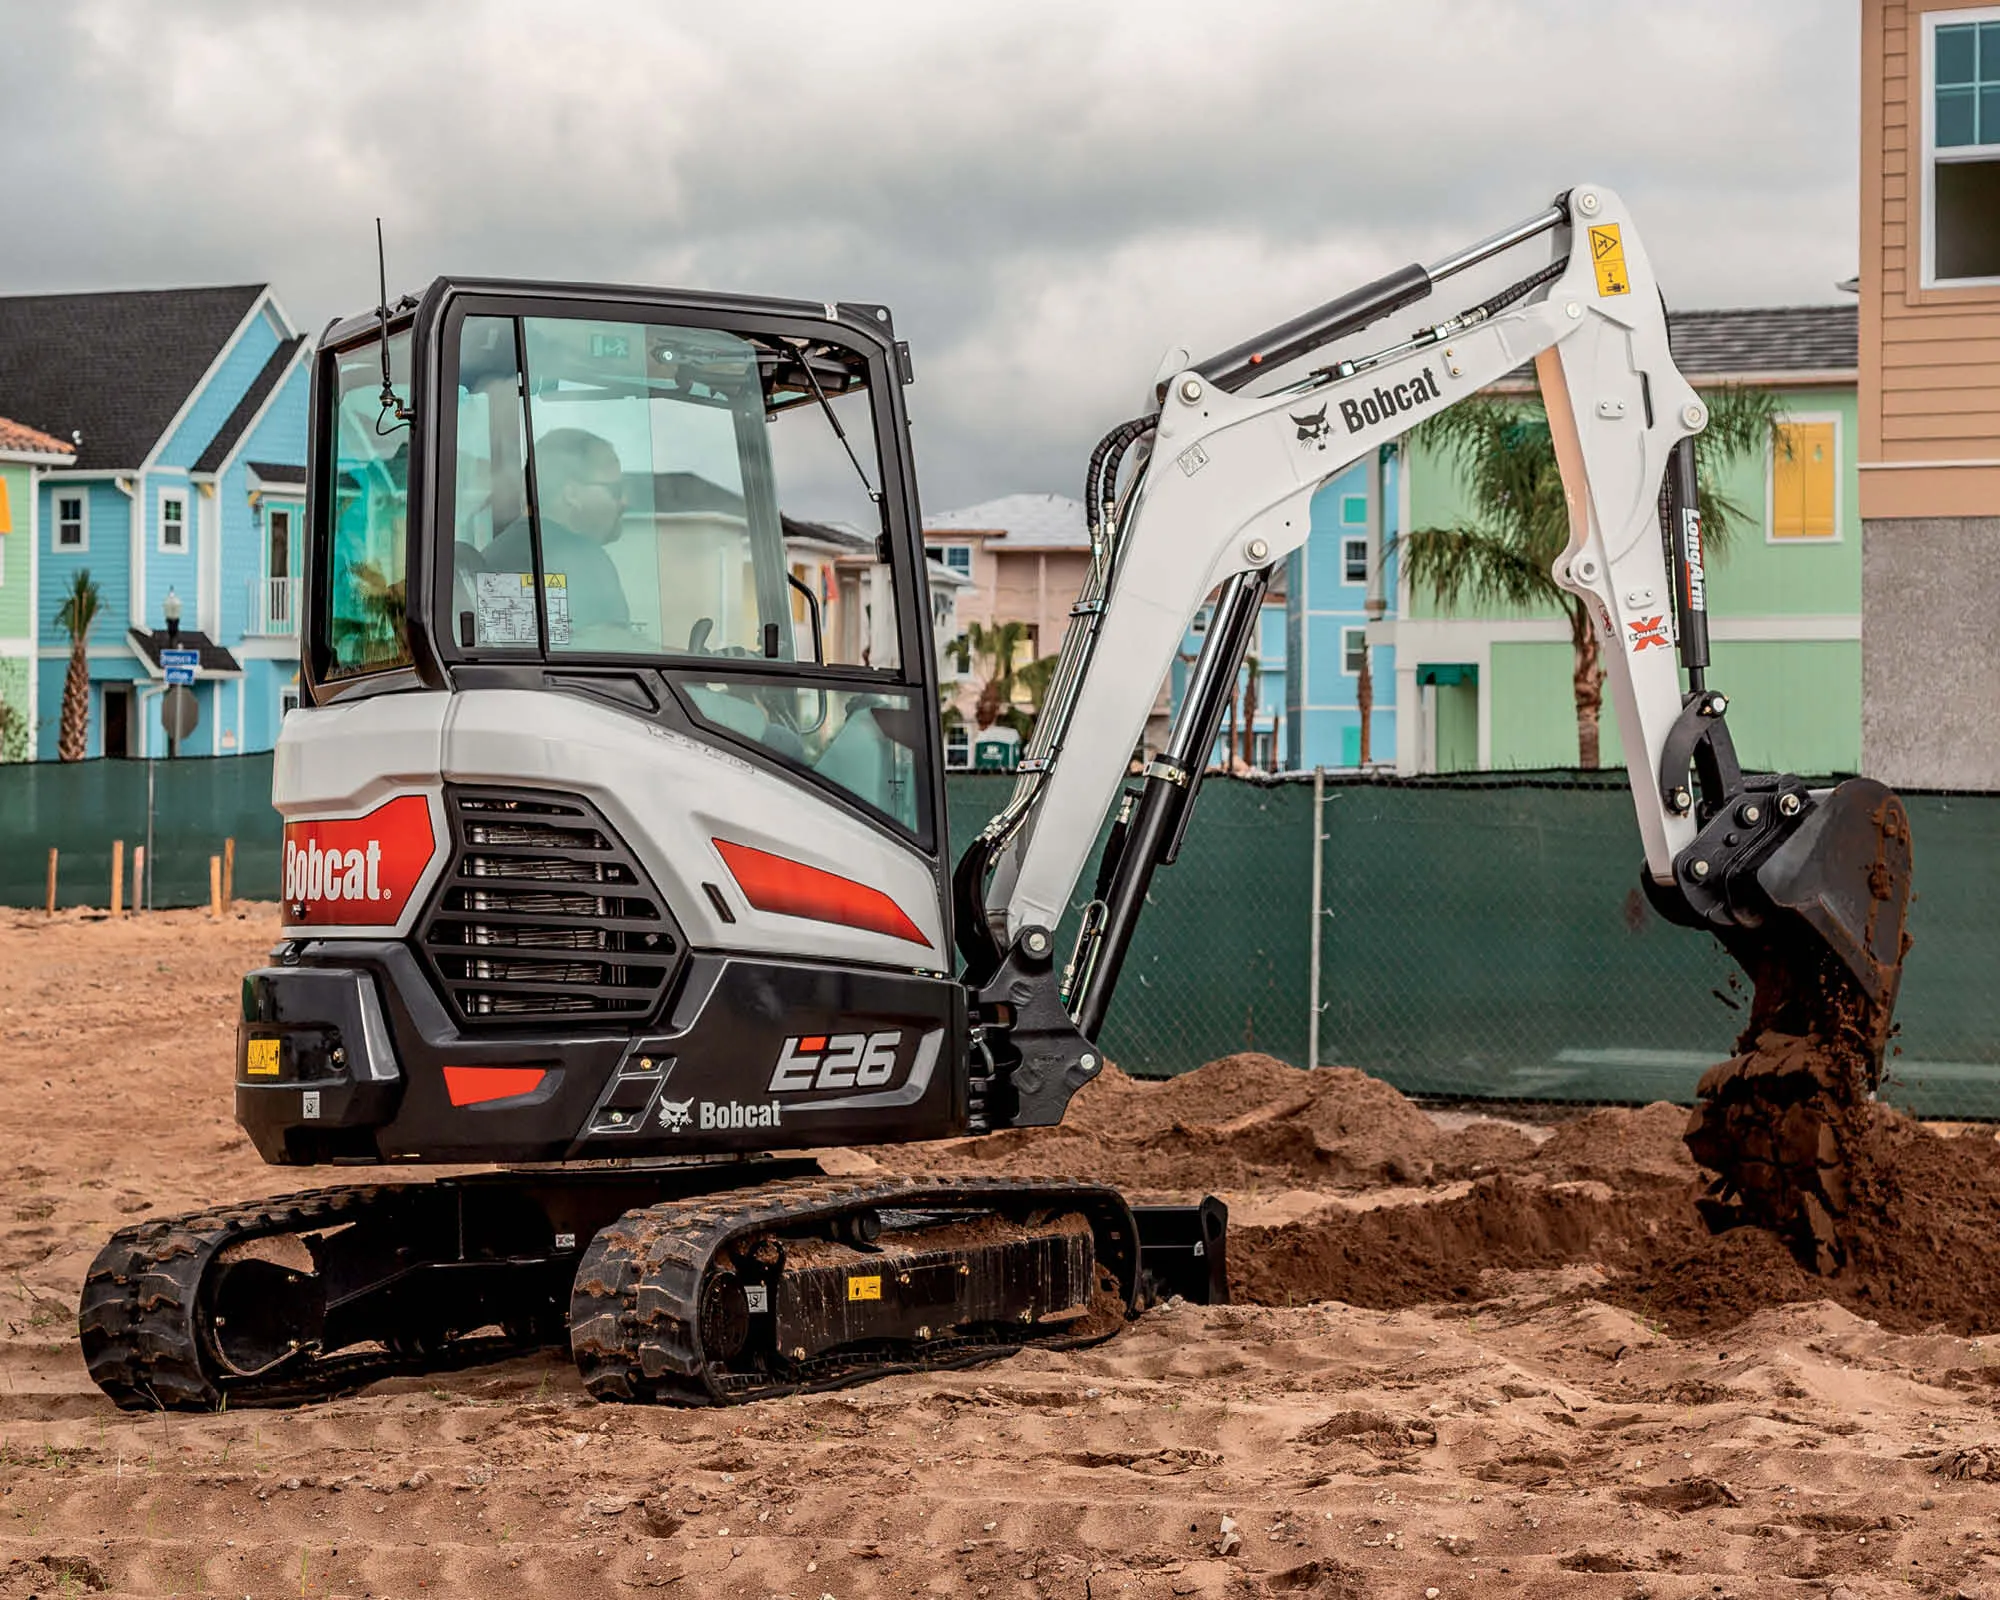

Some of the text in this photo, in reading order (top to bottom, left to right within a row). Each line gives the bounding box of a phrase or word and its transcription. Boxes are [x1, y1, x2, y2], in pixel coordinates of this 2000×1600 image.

[1339, 367, 1440, 434] Bobcat
[1686, 508, 1704, 612] LongArm
[286, 839, 381, 901] Bobcat
[768, 1031, 901, 1092] E26
[700, 1101, 782, 1130] Bobcat
